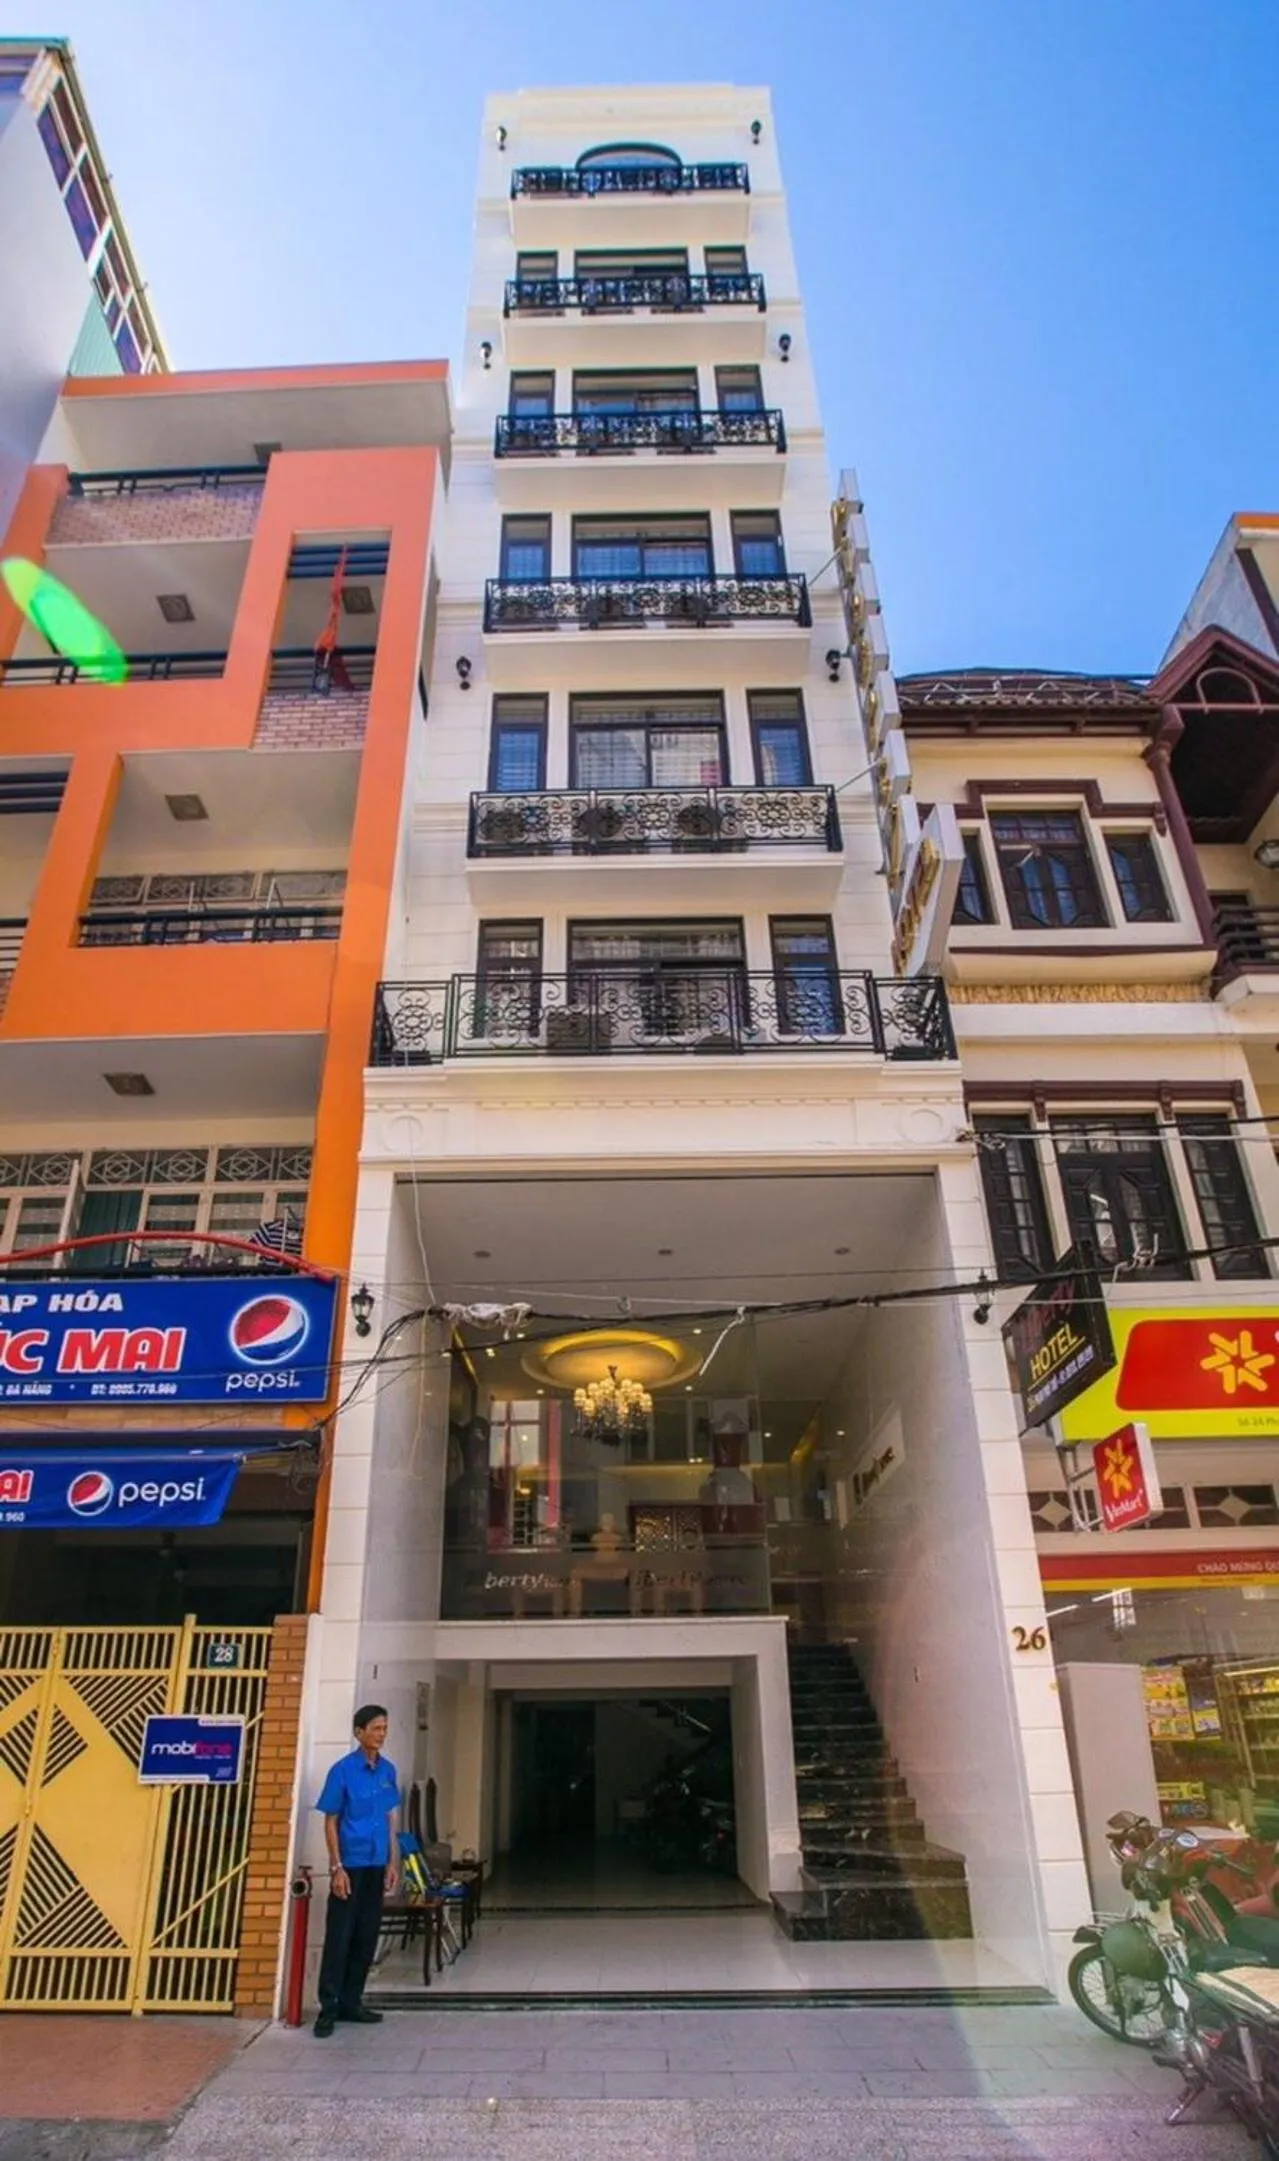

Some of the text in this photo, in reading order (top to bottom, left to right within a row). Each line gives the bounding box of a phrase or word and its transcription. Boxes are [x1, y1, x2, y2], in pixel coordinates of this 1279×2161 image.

[48, 1289, 124, 1313] HÓA
[56, 1326, 187, 1374] MAI
[1029, 1322, 1079, 1381] HOTEL
[225, 1369, 295, 1393] pepsi
[118, 1477, 204, 1507] pepsi
[1011, 1625, 1047, 1651] 26
[214, 1646, 235, 1664] 28
